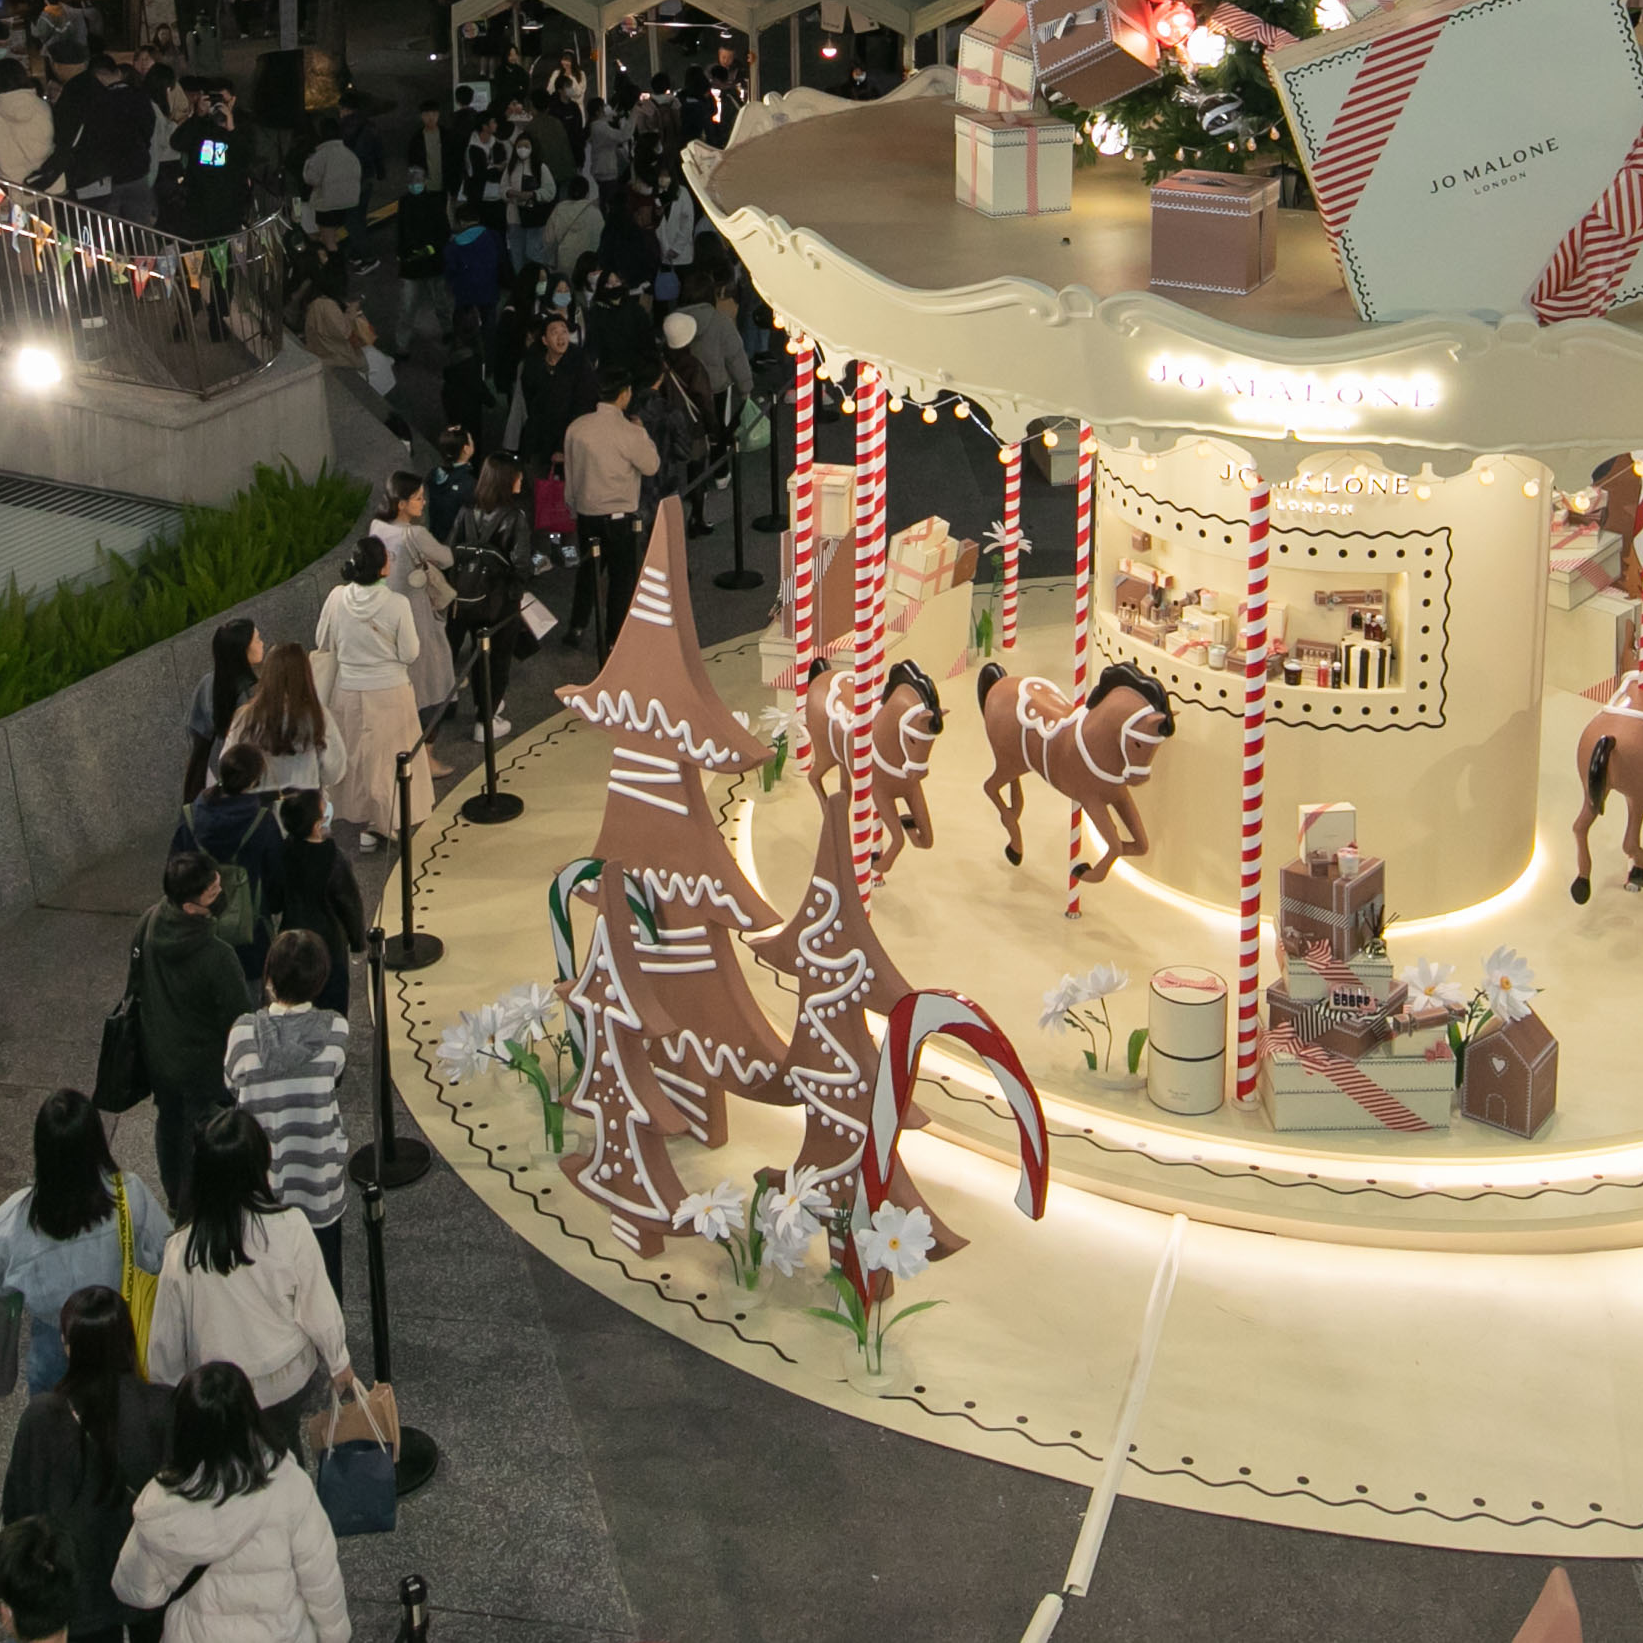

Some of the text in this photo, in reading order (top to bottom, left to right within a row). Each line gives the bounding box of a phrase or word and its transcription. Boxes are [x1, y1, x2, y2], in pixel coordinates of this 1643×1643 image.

[1430, 137, 1559, 194] JO MALONE
[1474, 171, 1527, 195] LONDON
[1149, 361, 1436, 408] JO MALONE
[1275, 498, 1355, 516] LONDON
